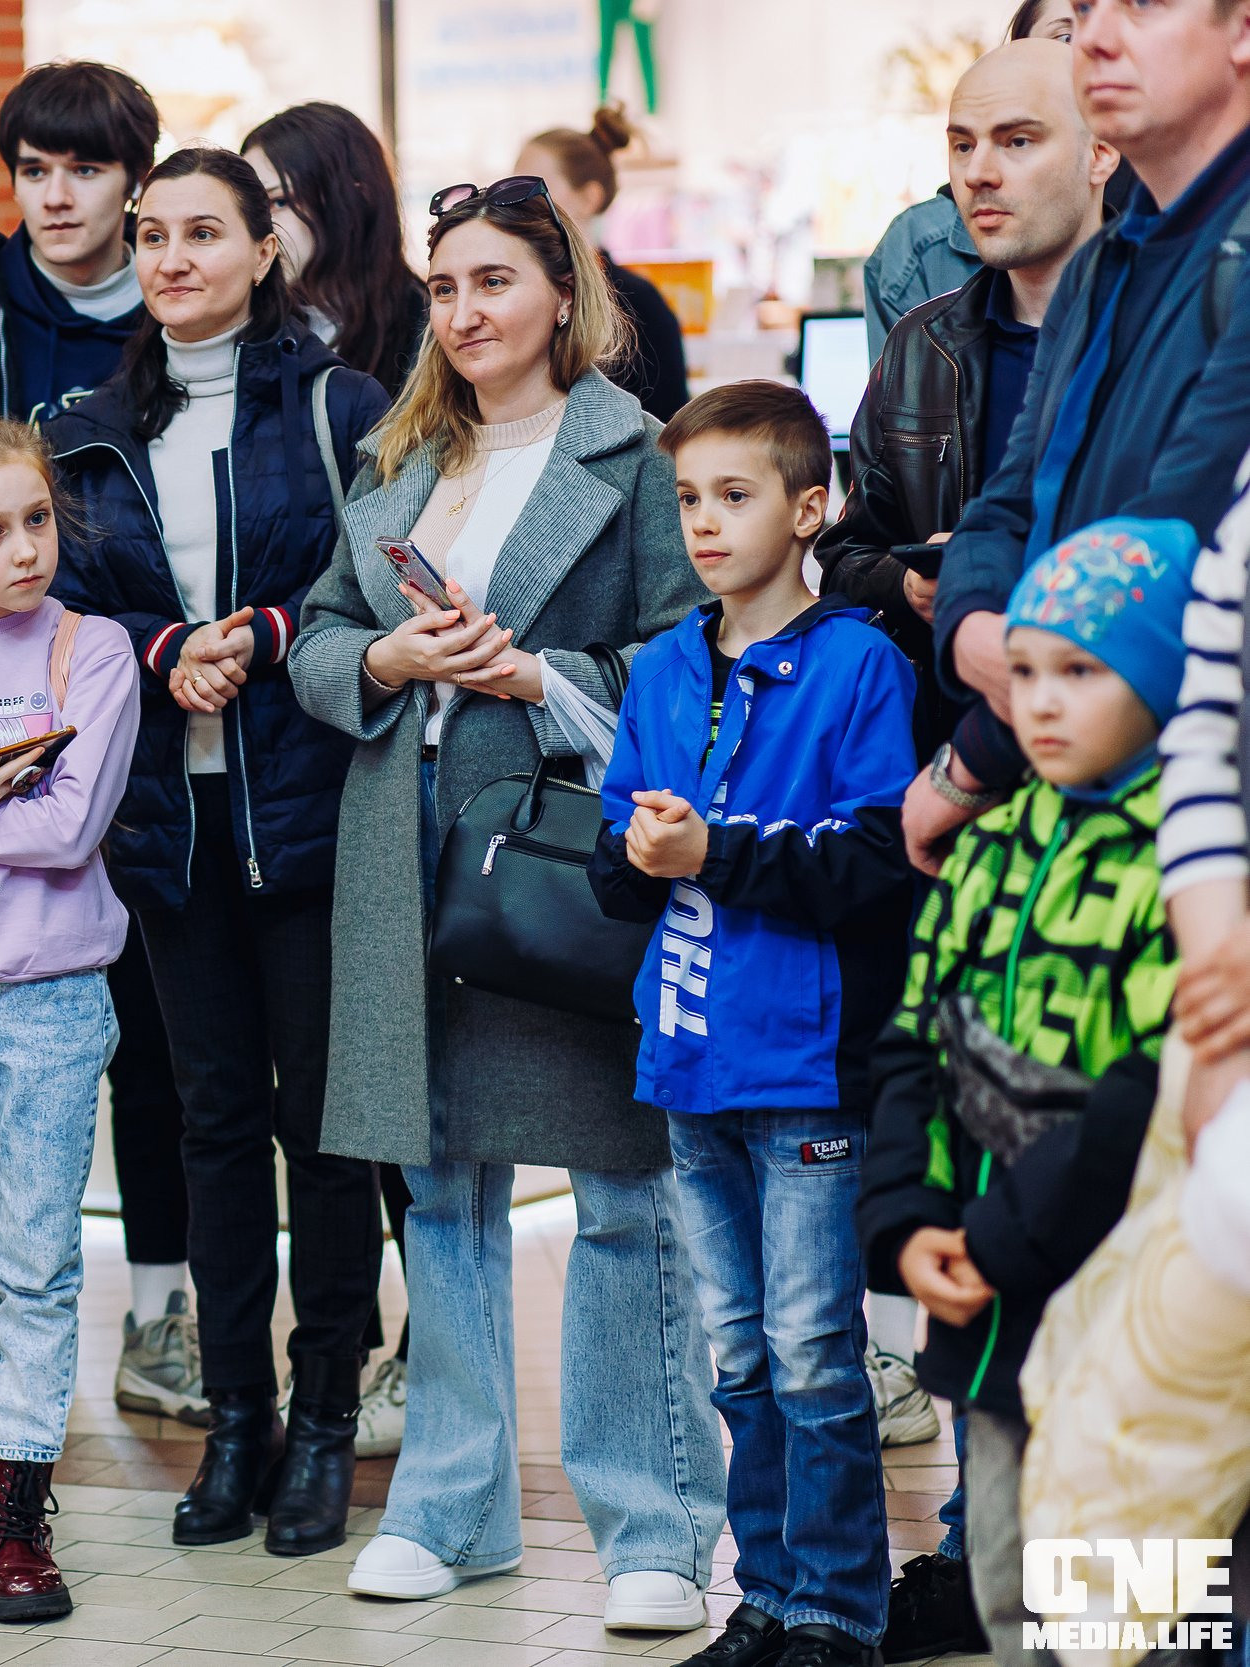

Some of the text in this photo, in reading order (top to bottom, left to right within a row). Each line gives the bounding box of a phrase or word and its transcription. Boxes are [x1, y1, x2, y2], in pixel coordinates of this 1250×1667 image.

[659, 874, 714, 1038] THU
[811, 1138, 849, 1154] TEAM
[817, 1150, 846, 1161] Together
